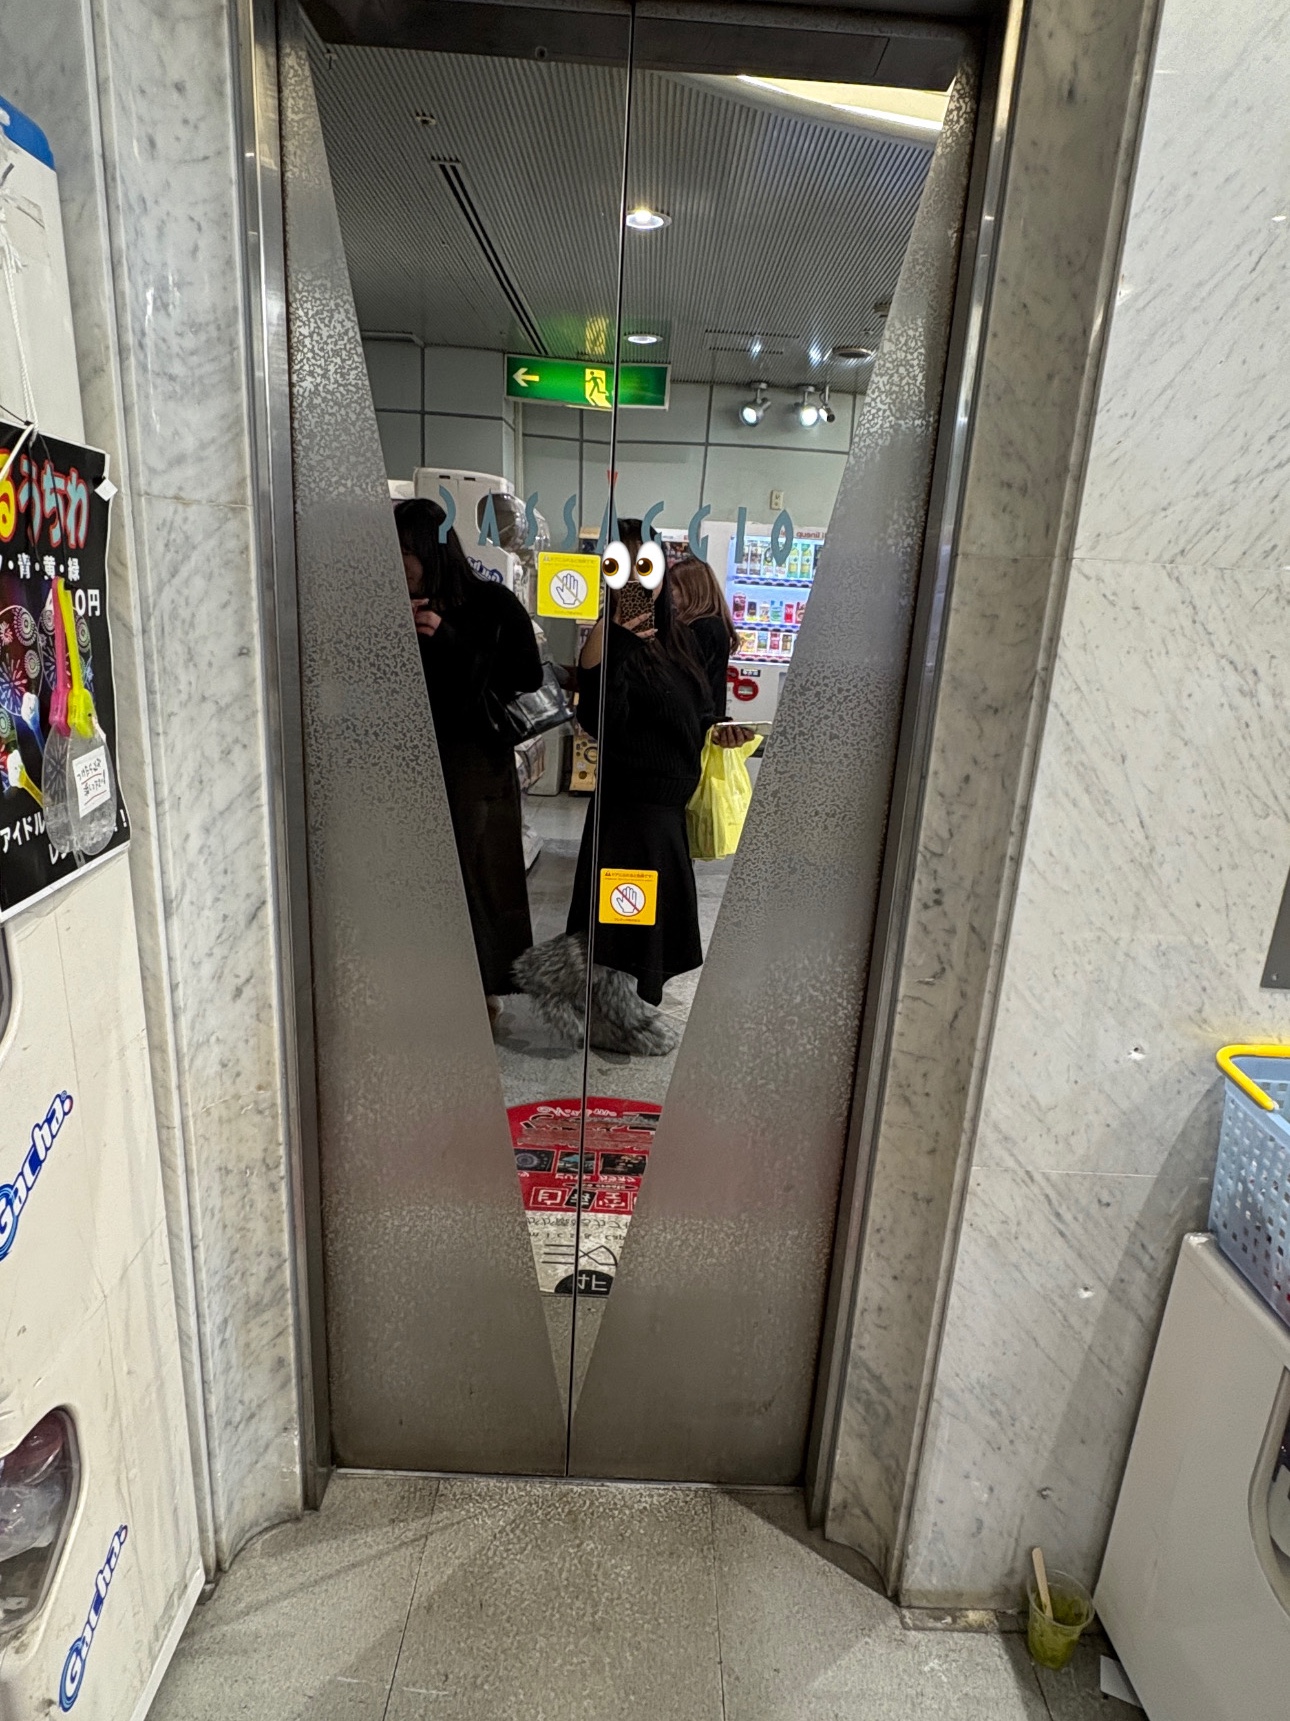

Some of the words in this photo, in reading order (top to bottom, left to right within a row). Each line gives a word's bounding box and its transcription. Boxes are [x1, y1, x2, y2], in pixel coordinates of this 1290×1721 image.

[0, 552, 80, 582] ・青・黄・緑
